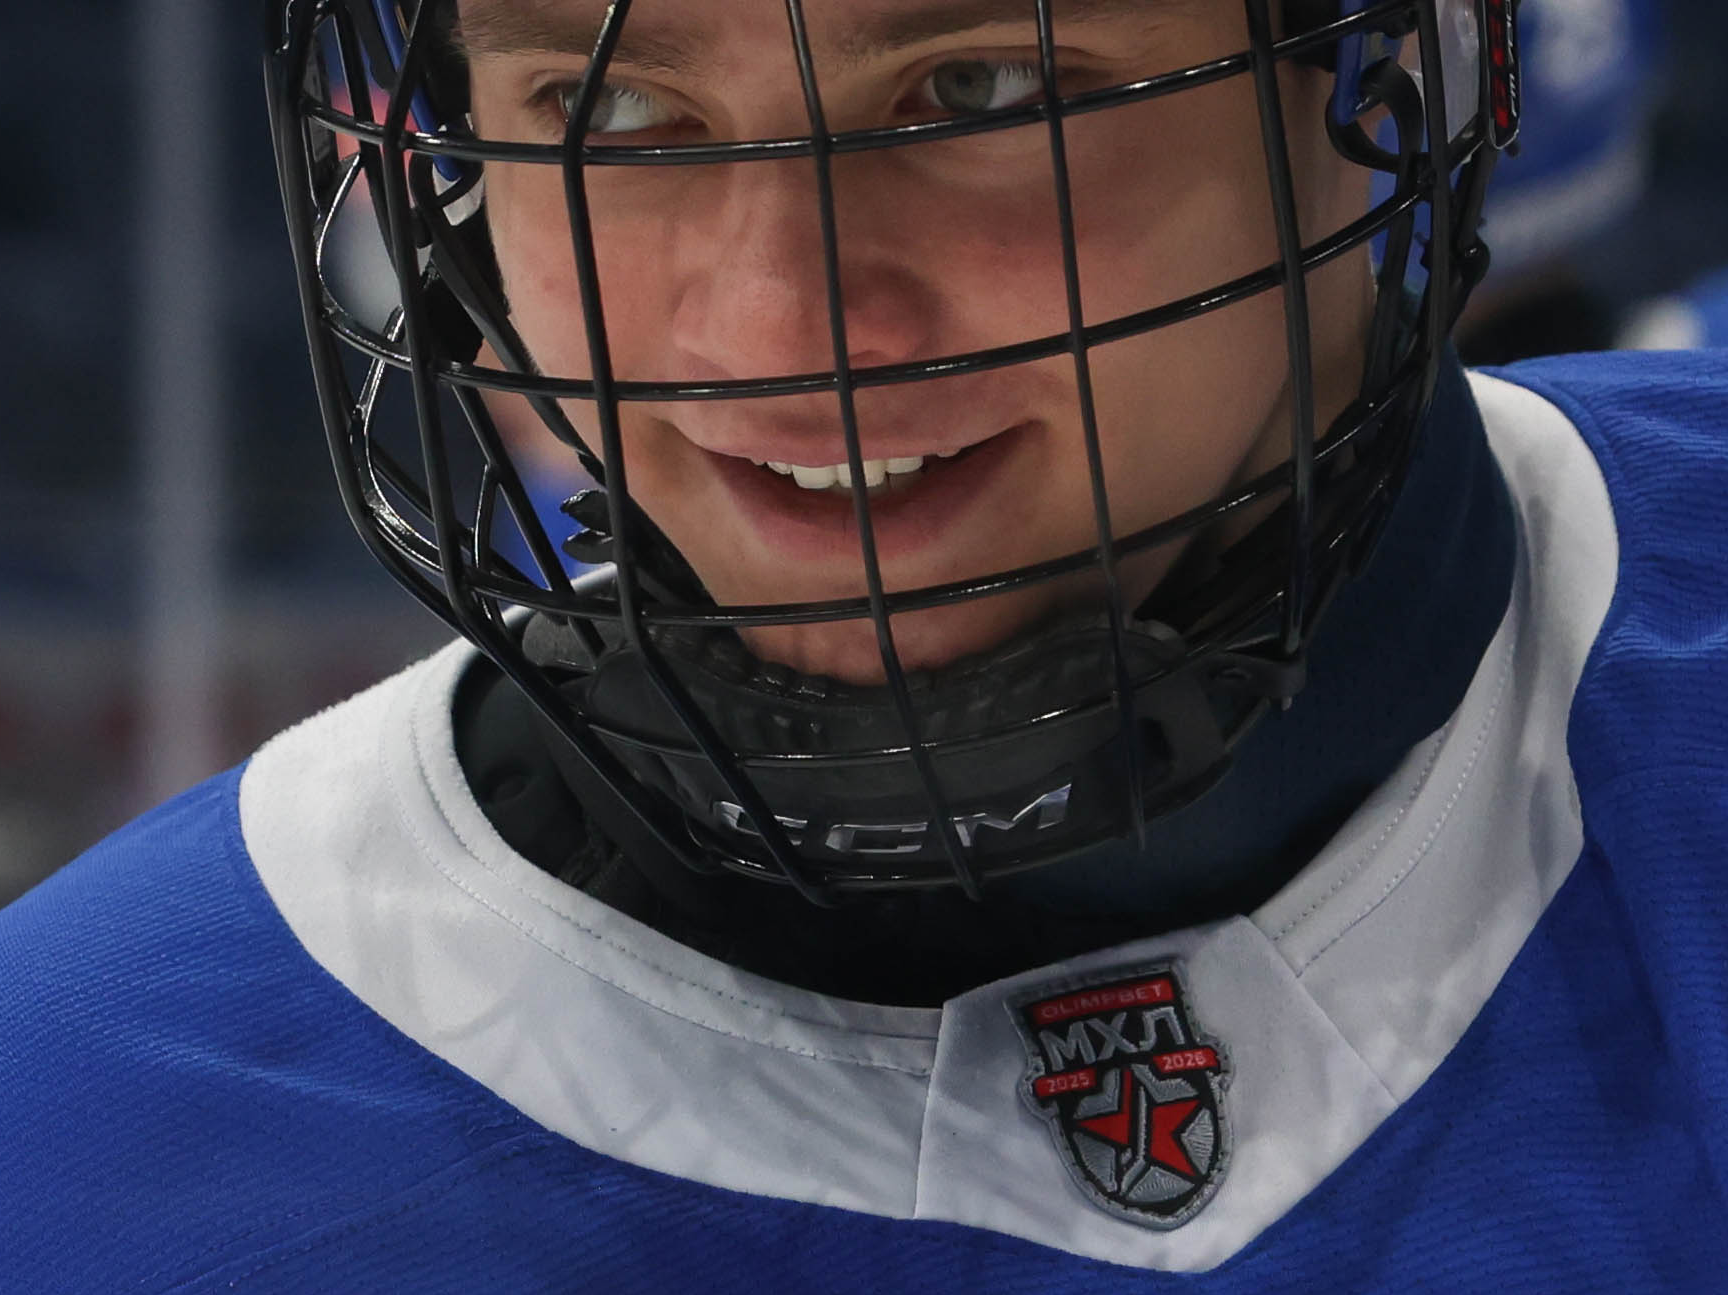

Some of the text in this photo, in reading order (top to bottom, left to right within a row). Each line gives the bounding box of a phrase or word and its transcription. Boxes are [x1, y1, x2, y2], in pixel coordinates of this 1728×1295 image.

[1040, 983, 1165, 1019] OLIMPBET
[1039, 1006, 1185, 1071] МХЛ
[1048, 1072, 1091, 1093] 2025
